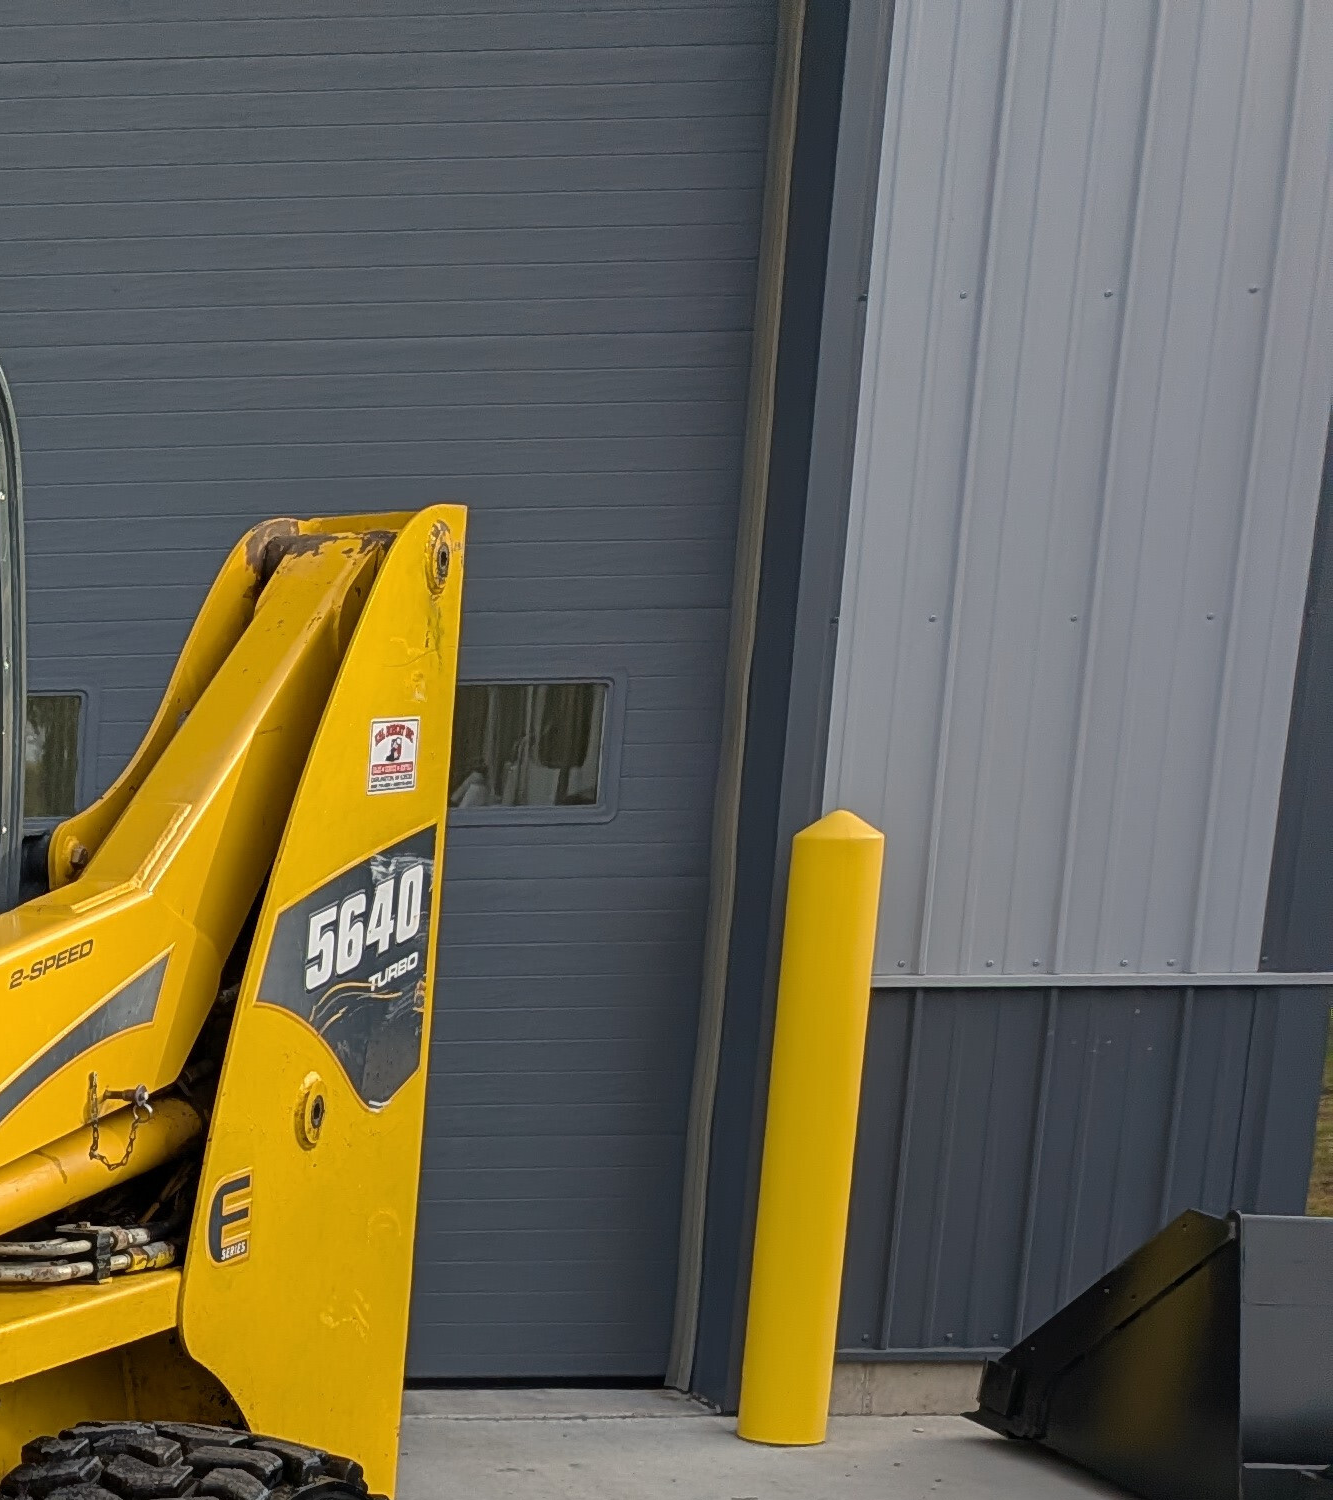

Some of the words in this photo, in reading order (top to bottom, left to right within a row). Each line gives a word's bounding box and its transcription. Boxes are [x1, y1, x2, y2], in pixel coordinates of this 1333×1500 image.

[305, 864, 424, 991] 5640
[9, 939, 93, 990] 2-SPEED
[368, 951, 419, 992] TURBO
[220, 1241, 247, 1261] SERIES
